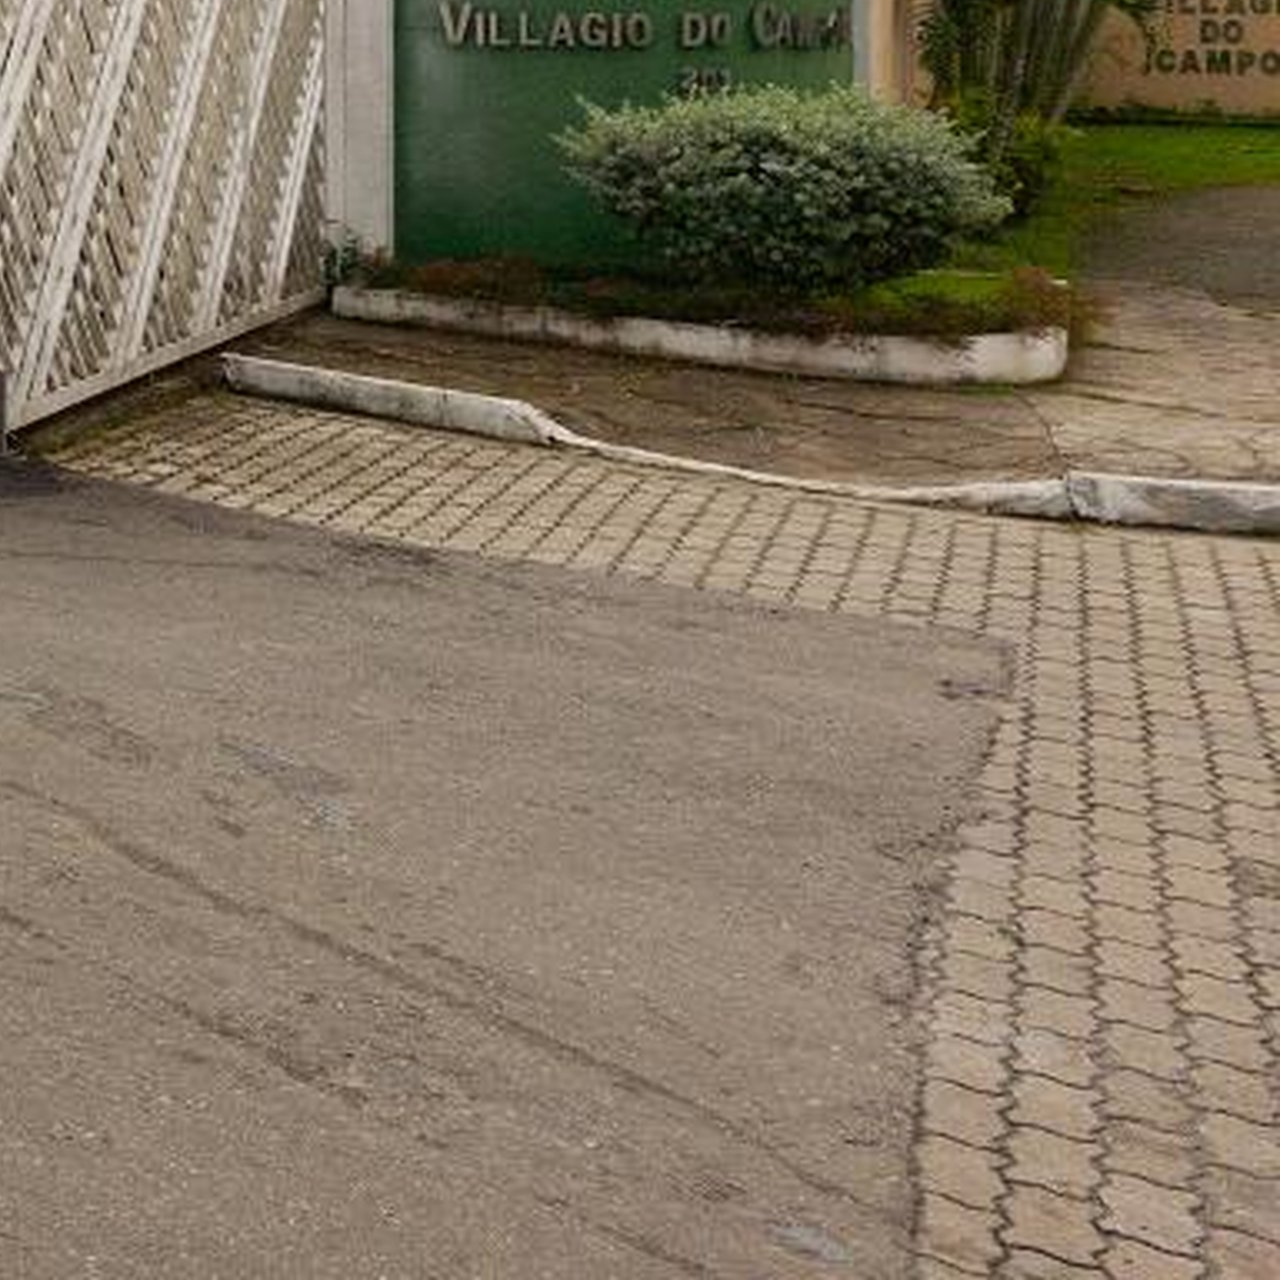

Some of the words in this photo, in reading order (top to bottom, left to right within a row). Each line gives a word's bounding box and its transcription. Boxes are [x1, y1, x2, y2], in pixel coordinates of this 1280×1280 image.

[440, 1, 652, 48] VILLAGIO
[681, 13, 732, 47] DO
[1200, 19, 1244, 45] DO
[1154, 48, 1279, 75] CAMPO
